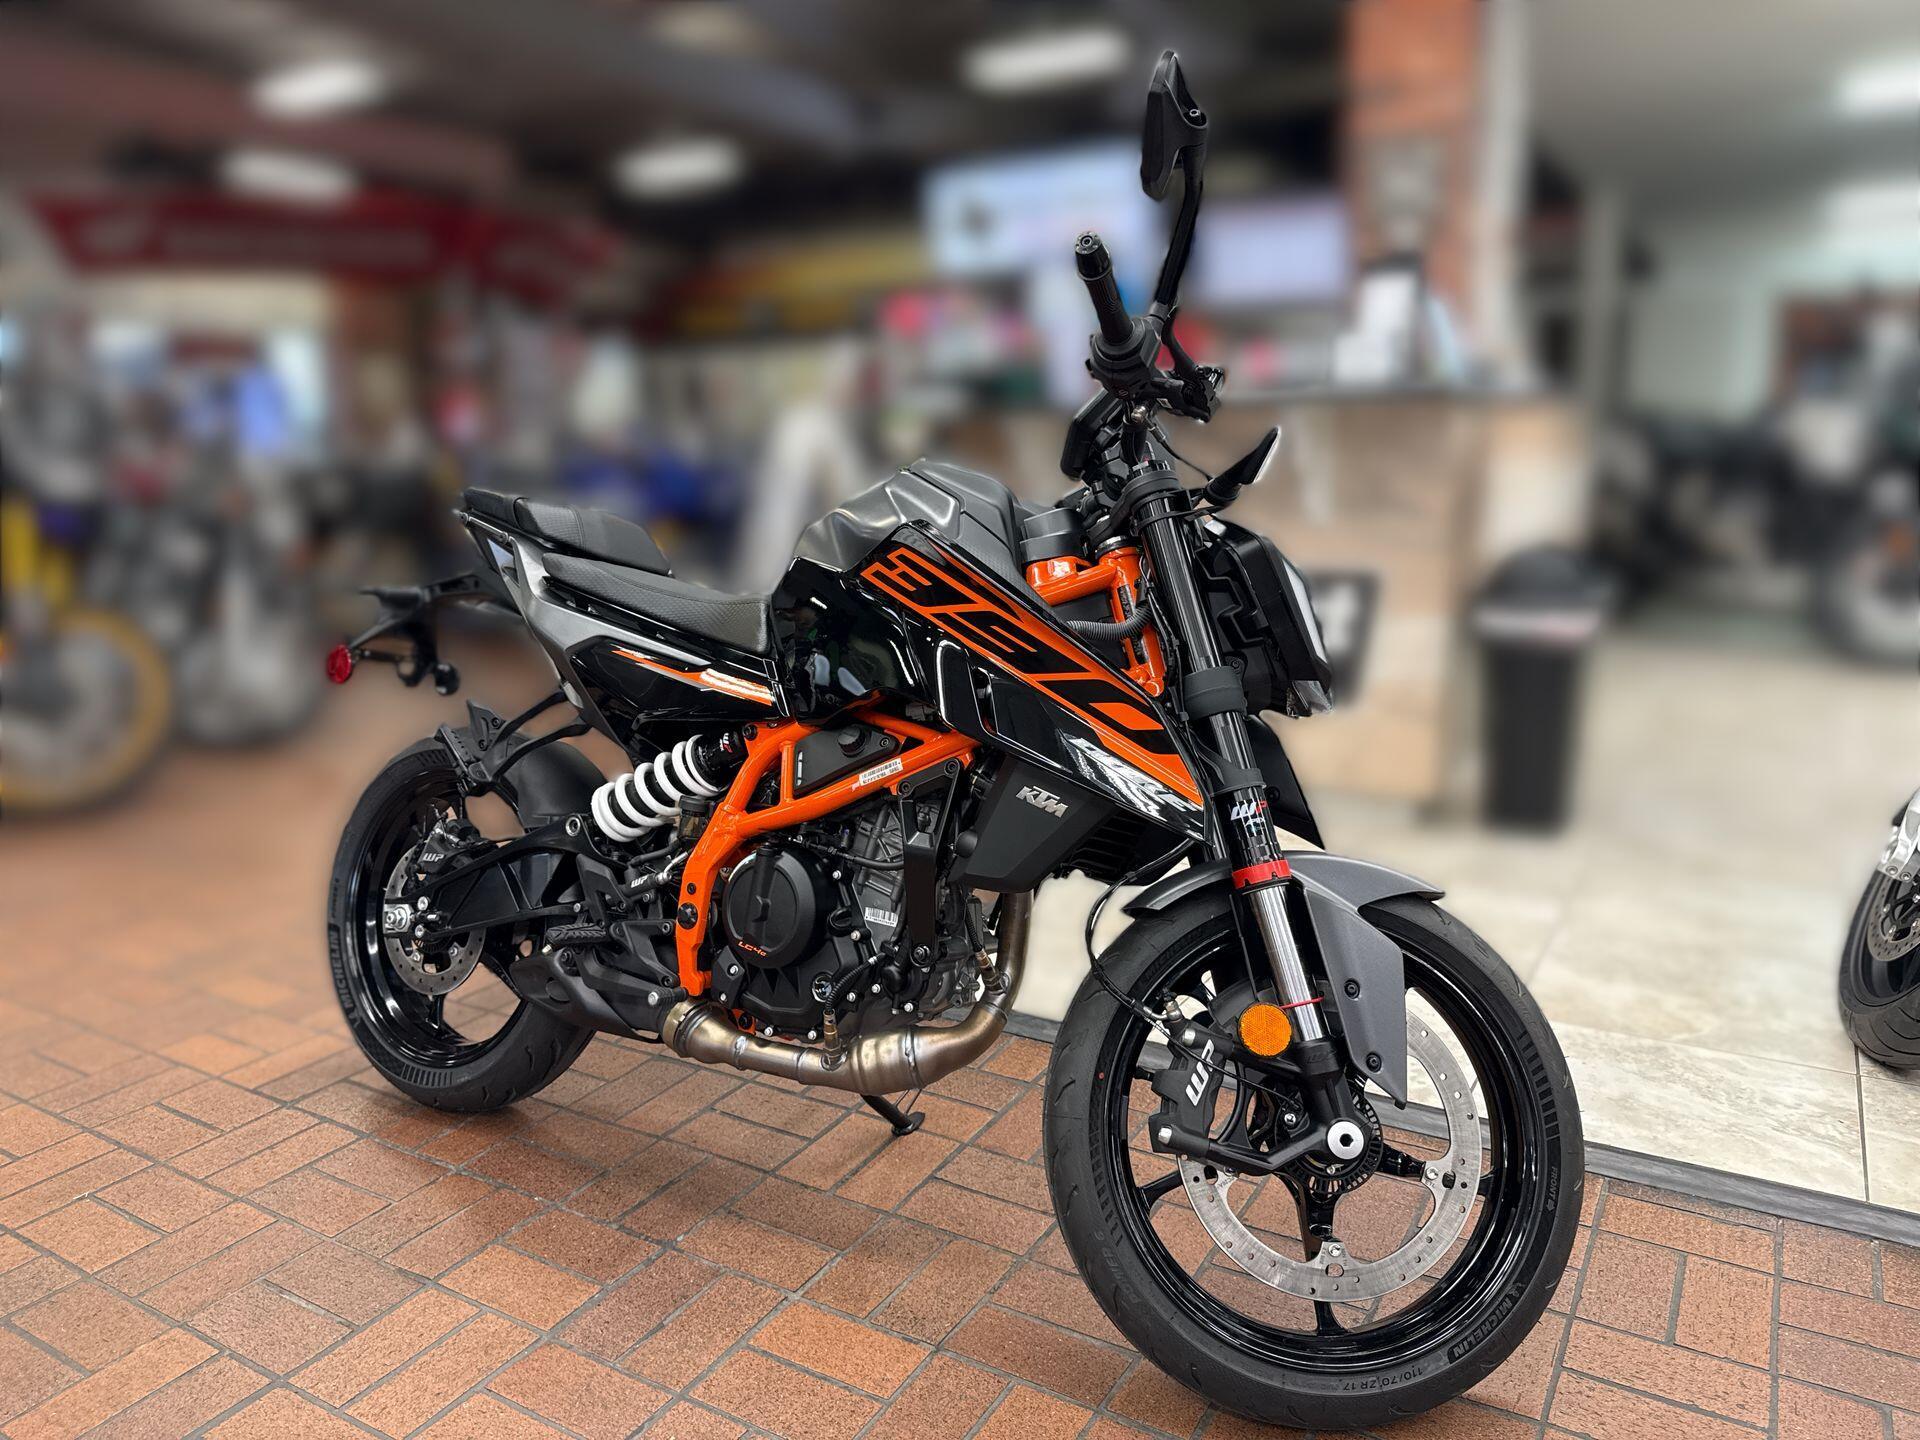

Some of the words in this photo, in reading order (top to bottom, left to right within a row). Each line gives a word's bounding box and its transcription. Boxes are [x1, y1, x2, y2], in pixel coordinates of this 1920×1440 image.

[1015, 785, 1069, 818] KTM
[1230, 800, 1268, 821] WP
[422, 853, 445, 862] WP
[630, 874, 649, 889] WP
[329, 929, 355, 1010] MICHELIN
[1185, 1038, 1215, 1106] WP
[1548, 1165, 1558, 1200] FRONT
[1452, 1296, 1513, 1358] MICHELIN
[1343, 1382, 1356, 1391] 17
[1359, 1377, 1377, 1390] ZR
[1382, 1366, 1423, 1387] 110/70
